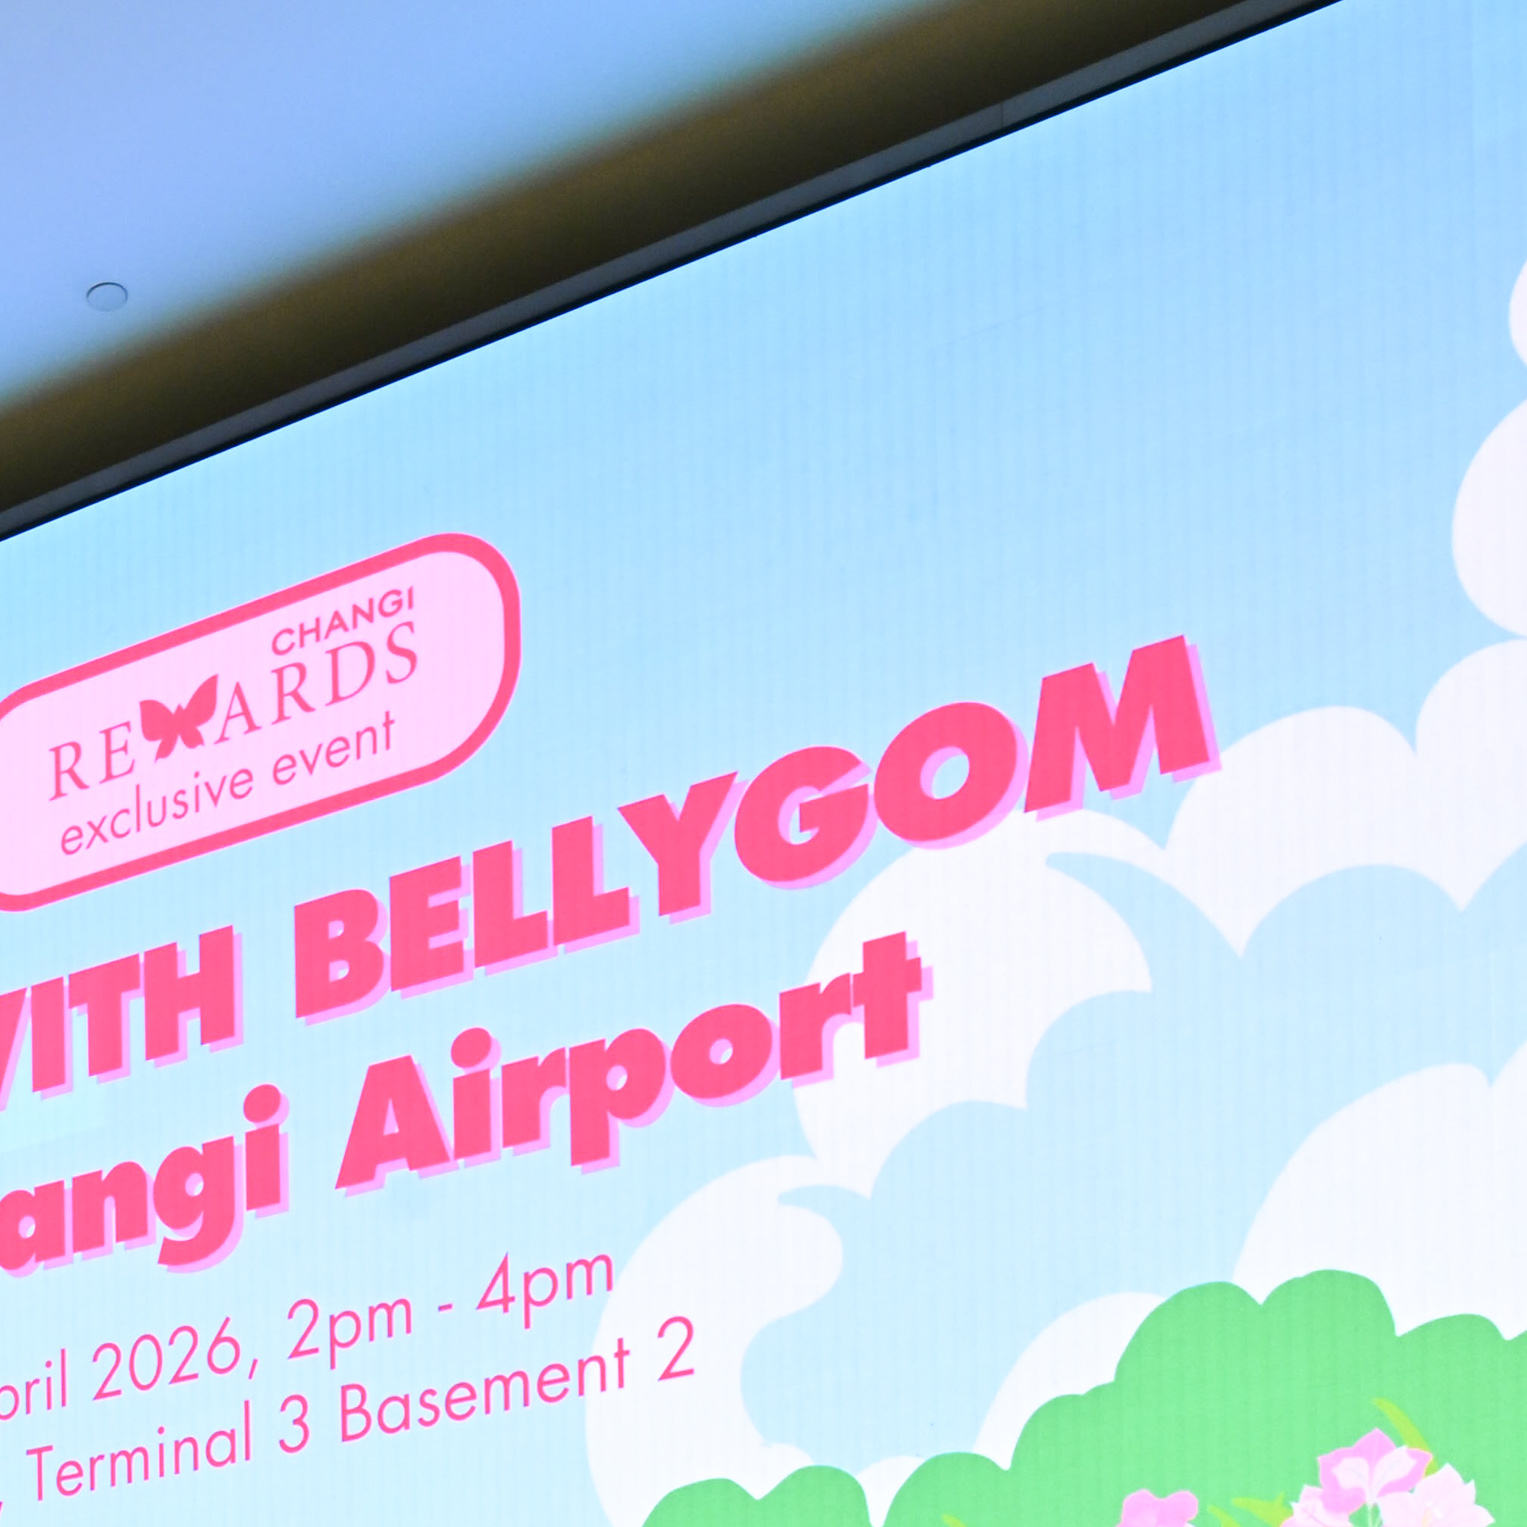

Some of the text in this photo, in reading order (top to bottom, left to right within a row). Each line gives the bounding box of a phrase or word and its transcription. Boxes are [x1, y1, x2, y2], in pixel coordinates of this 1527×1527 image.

[271, 585, 414, 657] CHANGI
[60, 710, 396, 856] exclusive event
[294, 635, 1218, 1022] BELLYGOM
[335, 931, 926, 1192] Airport
[26, 1398, 252, 1502] Terminal
[279, 1394, 310, 1454] 3
[340, 1337, 630, 1443] Basement
[657, 1315, 696, 1381] 2
[92, 1317, 260, 1401] 2026,
[287, 1298, 413, 1370] 2pm
[477, 1252, 614, 1330] 4pm
